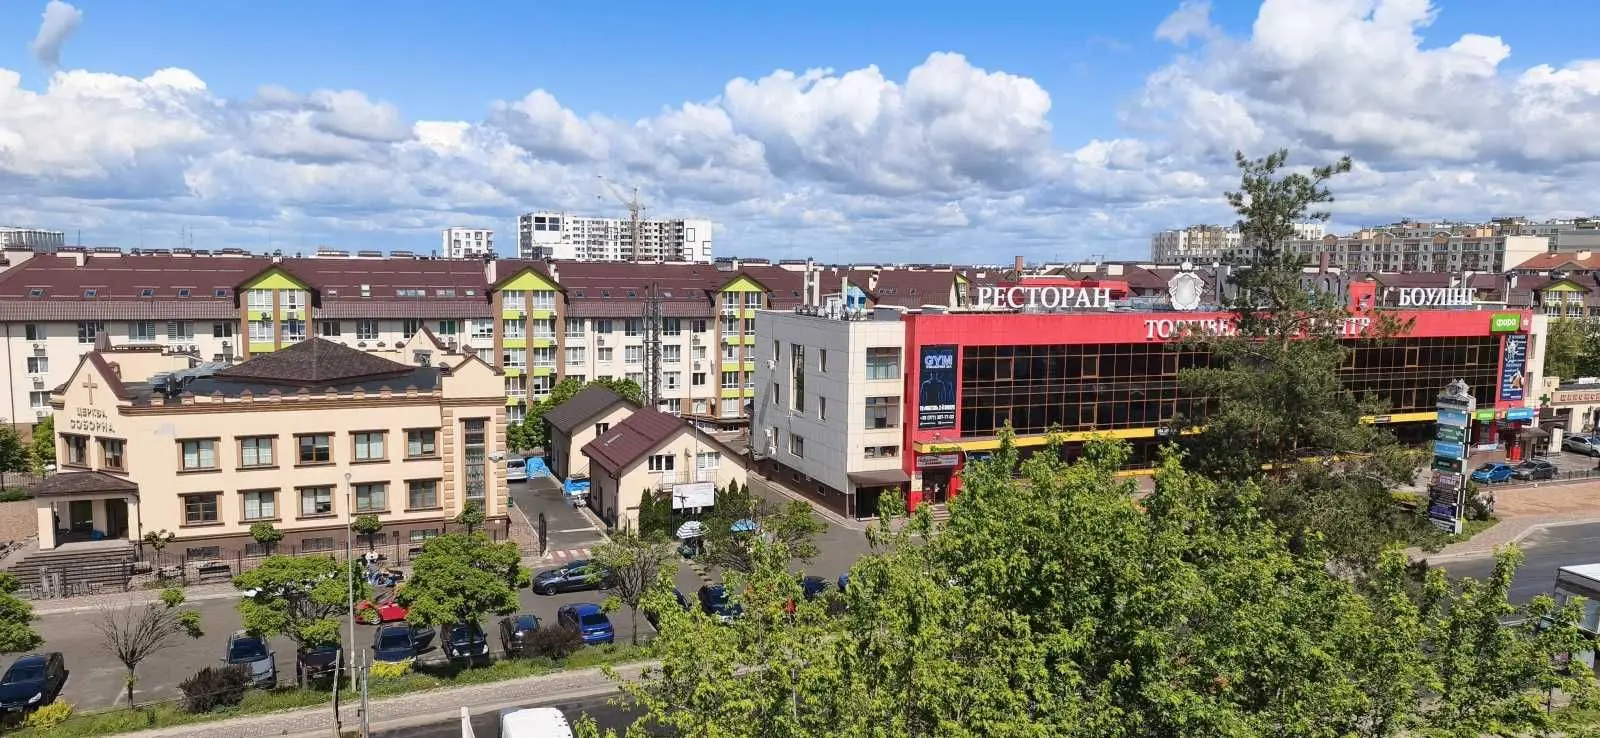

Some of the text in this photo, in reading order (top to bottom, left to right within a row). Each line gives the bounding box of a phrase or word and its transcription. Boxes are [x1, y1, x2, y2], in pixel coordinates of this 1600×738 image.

[977, 286, 1112, 308] РЕСТОРАН
[1398, 287, 1477, 306] БОУЛІНГ
[924, 355, 953, 366] GYM
[76, 407, 108, 418] ЦЕРКВА
[70, 419, 116, 433] СОБОРНА
